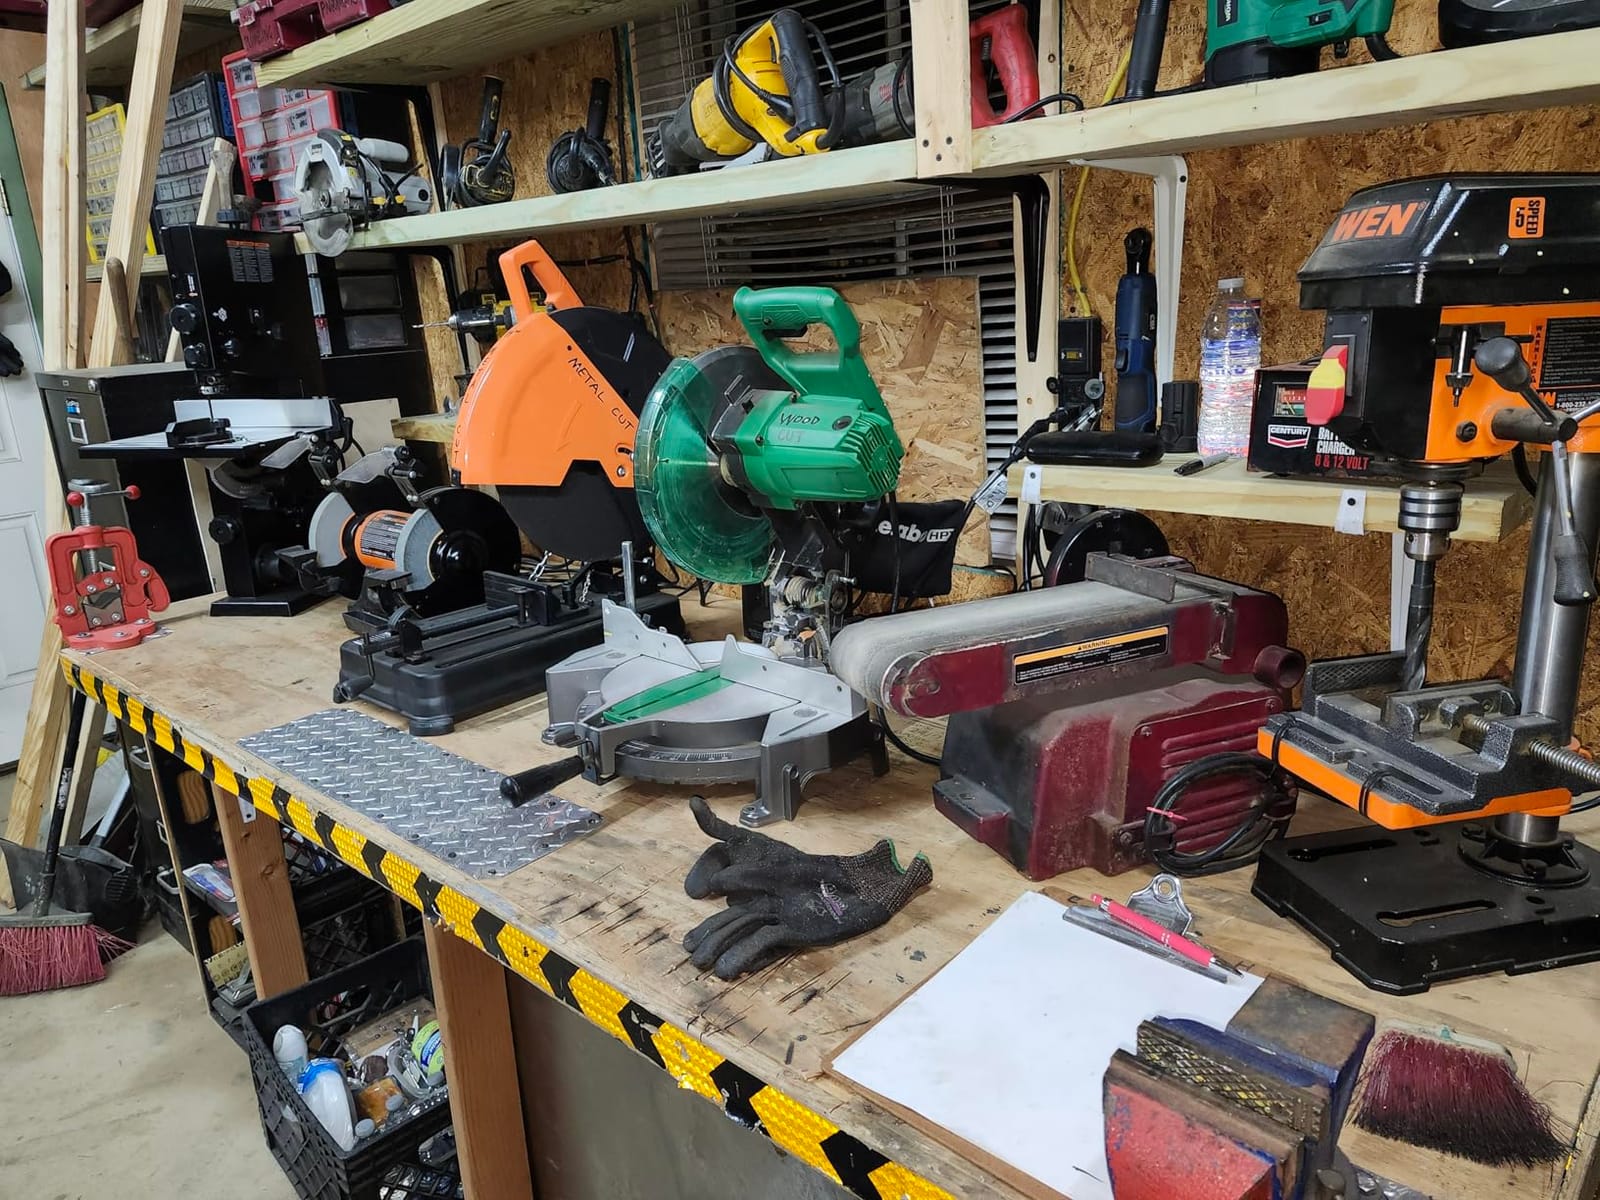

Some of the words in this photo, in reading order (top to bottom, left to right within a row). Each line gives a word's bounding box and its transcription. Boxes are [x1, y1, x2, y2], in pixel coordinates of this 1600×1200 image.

[1332, 202, 1419, 241] WEN
[1515, 207, 1525, 228] 5
[1526, 199, 1541, 235] SPEED
[568, 358, 604, 404] METAL
[611, 407, 635, 430] CUT
[780, 412, 821, 426] WOOD
[777, 428, 805, 443] CUT
[1270, 427, 1308, 435] CENTURY
[1334, 455, 1344, 468] 12
[1346, 455, 1369, 470] VOLT
[1082, 639, 1110, 650] WARNING
